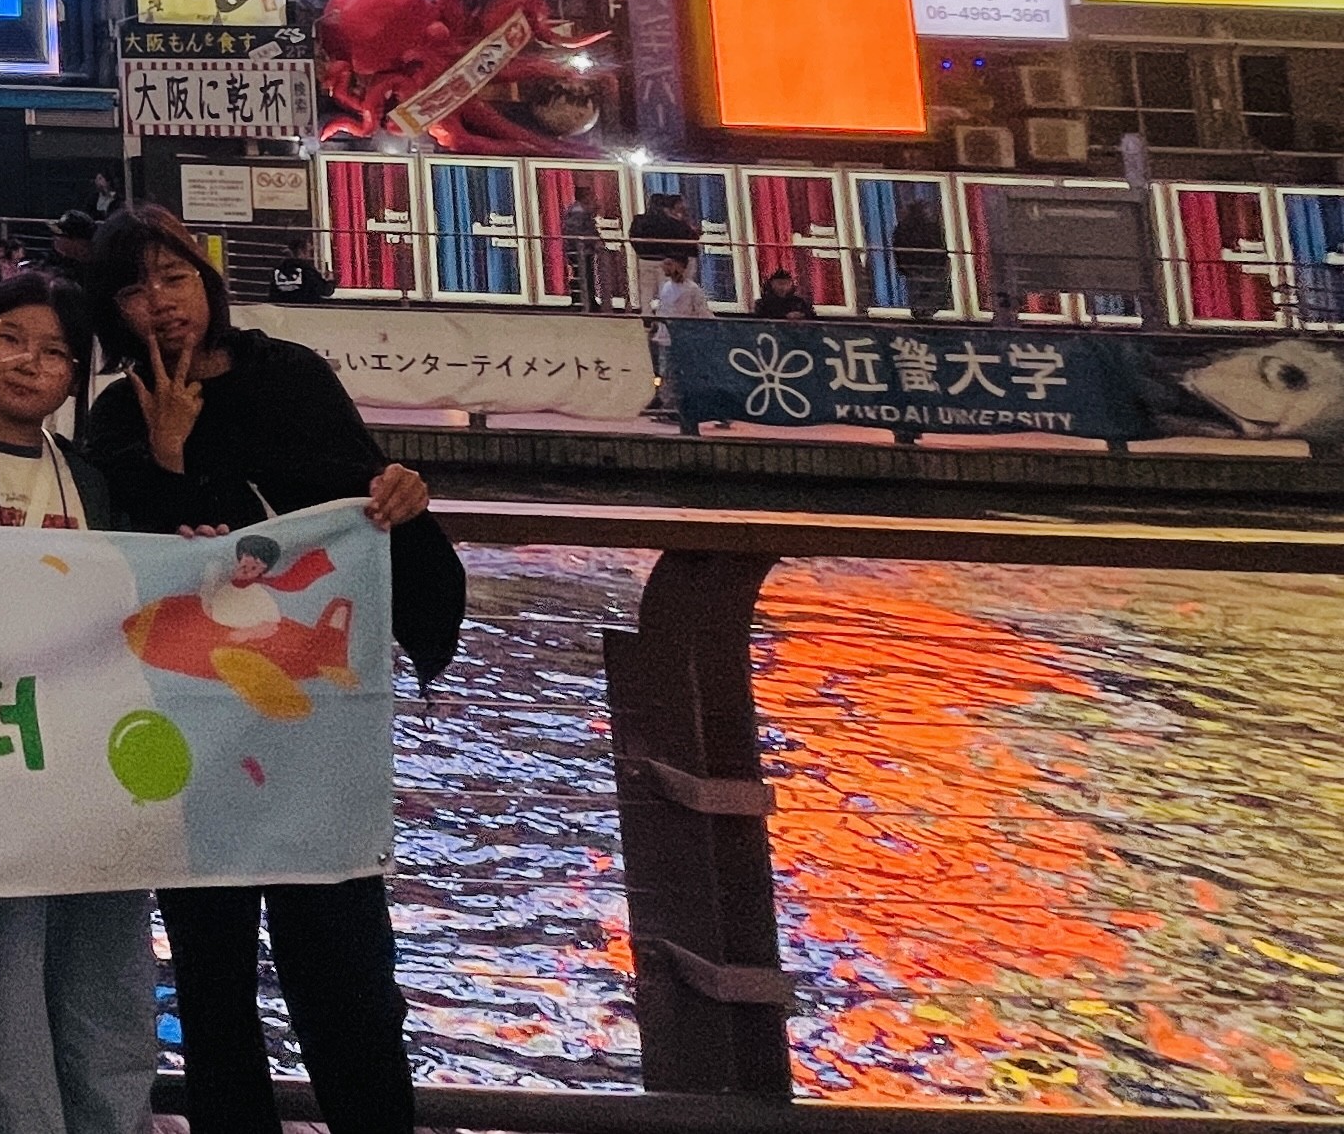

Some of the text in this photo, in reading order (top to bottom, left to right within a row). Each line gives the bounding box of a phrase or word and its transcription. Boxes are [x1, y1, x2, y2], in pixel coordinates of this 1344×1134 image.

[134, 72, 287, 124] 大阪に乾杯
[823, 336, 1068, 400] 近畿大学
